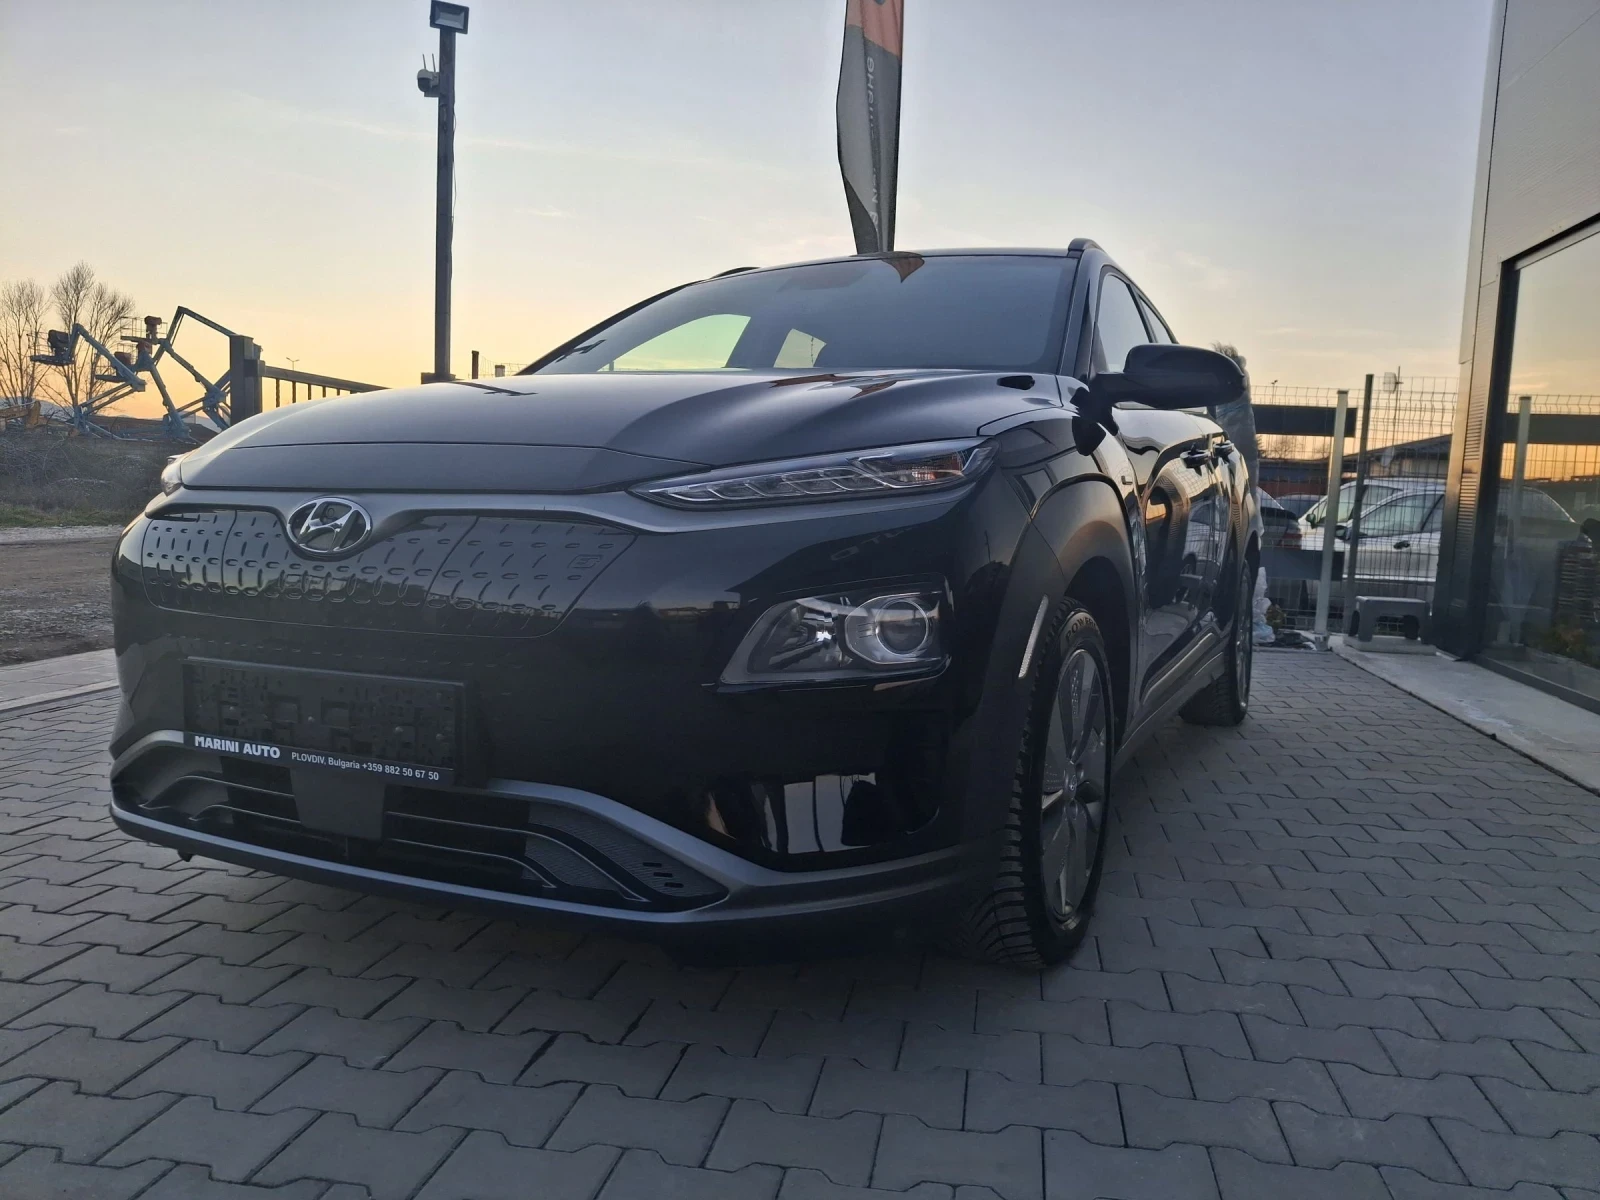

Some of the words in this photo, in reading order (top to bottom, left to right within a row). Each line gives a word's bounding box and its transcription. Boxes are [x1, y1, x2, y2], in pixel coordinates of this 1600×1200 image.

[194, 735, 240, 753] MARINI
[243, 743, 281, 759] AUTO
[328, 757, 360, 769] Bulgaria
[362, 762, 383, 773] +359
[384, 764, 400, 775] 882
[402, 767, 413, 777] 50
[415, 769, 425, 779] 67
[428, 771, 440, 781] 50
